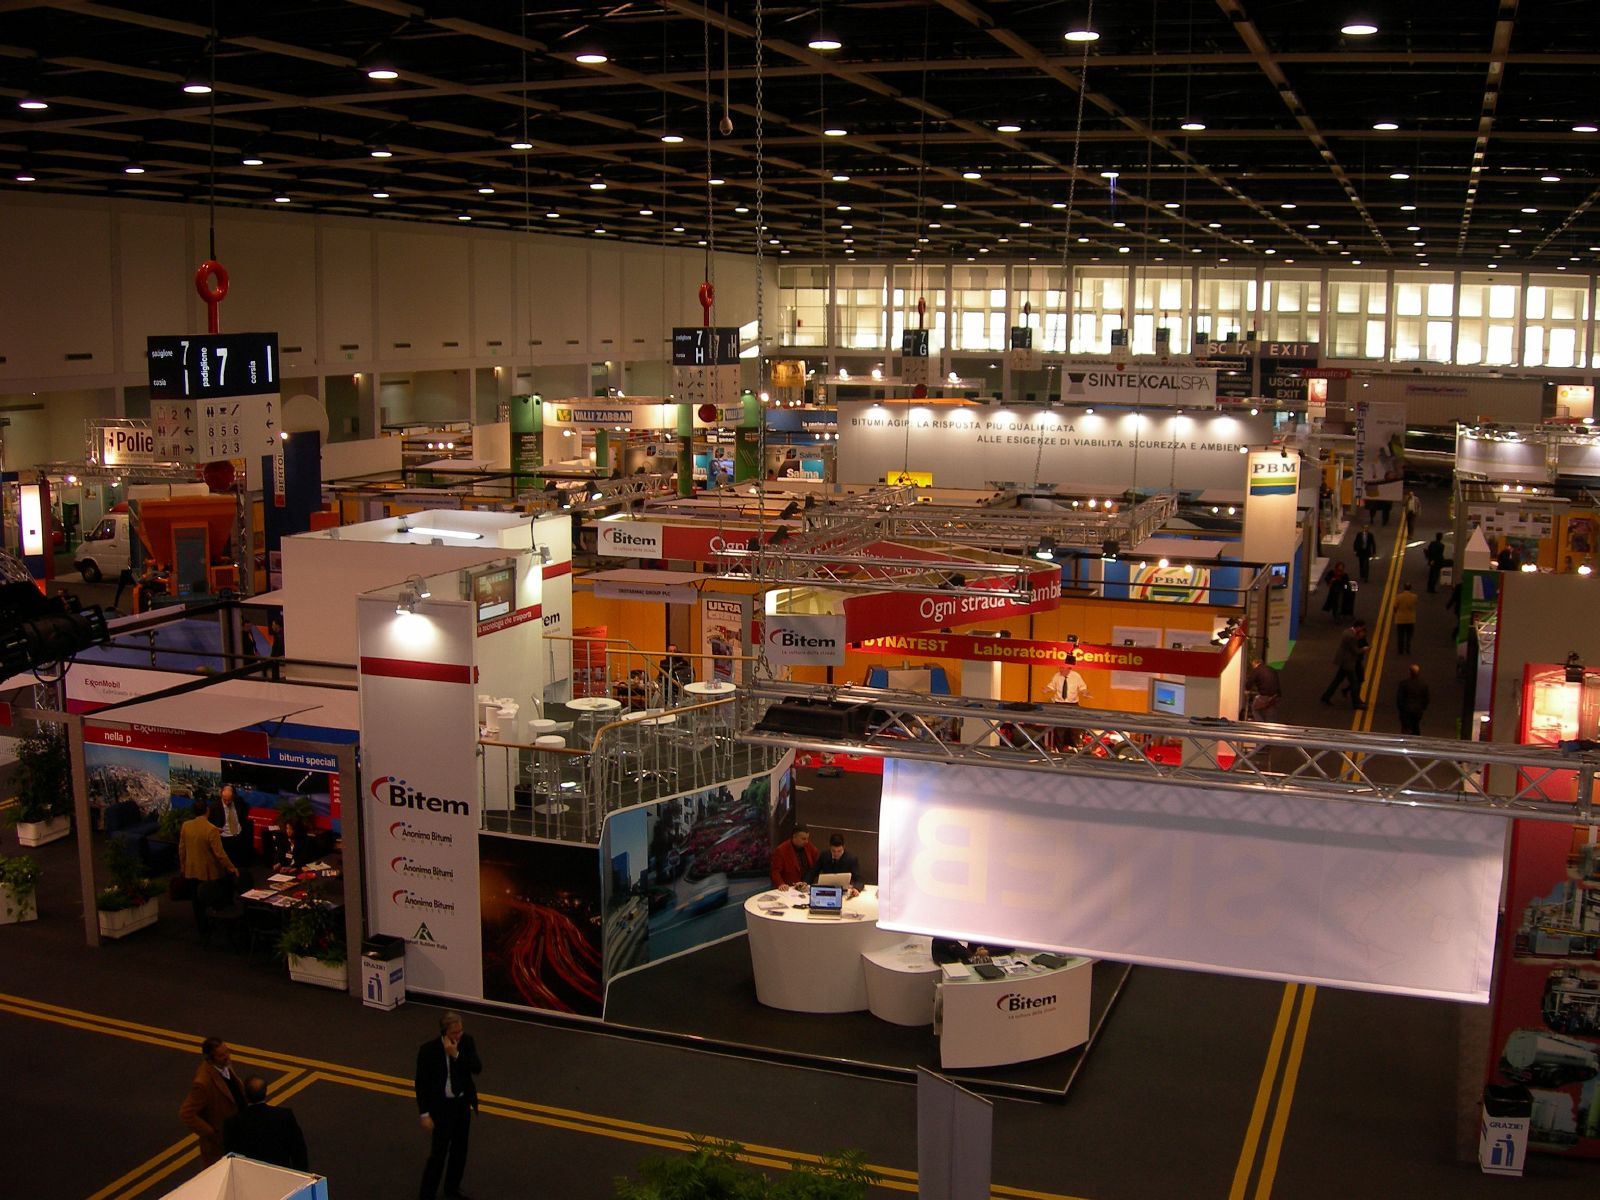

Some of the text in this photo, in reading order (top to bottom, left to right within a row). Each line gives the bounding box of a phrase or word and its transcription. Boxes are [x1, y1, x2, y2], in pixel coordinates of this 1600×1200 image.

[697, 331, 704, 346] 7
[181, 341, 190, 366] 7
[695, 347, 704, 364] H
[1269, 344, 1309, 356] EXIT
[201, 347, 228, 387] padiglione 7
[1268, 377, 1308, 387] USCITA
[1276, 389, 1300, 399] EXIT
[852, 418, 884, 427] BITUMI
[917, 421, 930, 429] LA
[932, 421, 981, 430] RISPOSTA
[977, 435, 1002, 444] ALLE
[1006, 435, 1057, 446] ESIGENZE
[1060, 438, 1071, 446] DI
[1128, 440, 1187, 451] SICUREZZA
[1190, 442, 1198, 451] E
[787, 460, 820, 478] Salima
[1253, 463, 1297, 475] PBM
[613, 531, 657, 546] Bitem
[1154, 576, 1189, 585] PBM
[708, 601, 742, 614] ULTRA
[920, 597, 957, 622] Ogni
[782, 632, 836, 648] Bitem
[863, 634, 949, 653] DYNATEST
[973, 643, 1144, 667] Laboratorio Centrale
[104, 730, 125, 743] nella
[279, 752, 337, 768] bitumi speciali
[389, 784, 470, 816] Bitem
[1009, 995, 1057, 1012] Bitem
[1489, 1121, 1523, 1130] GRAZIE!
